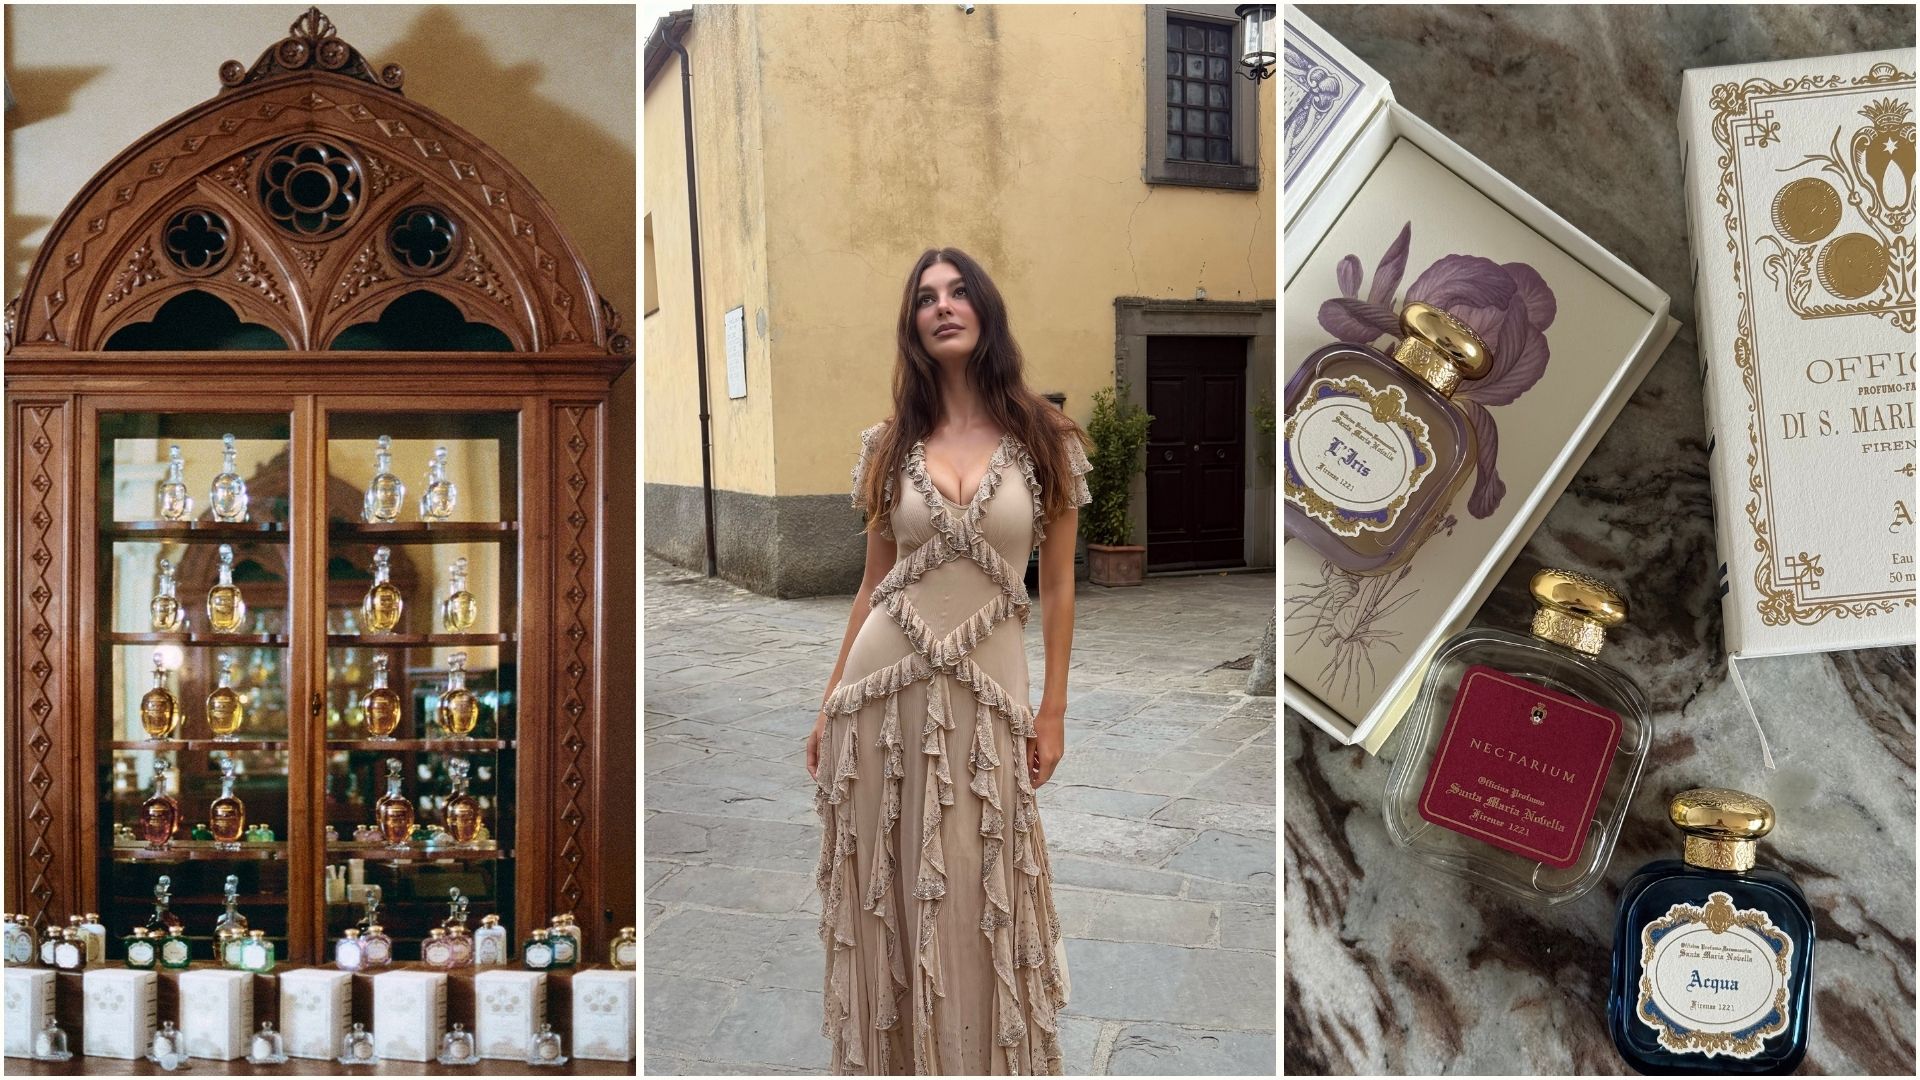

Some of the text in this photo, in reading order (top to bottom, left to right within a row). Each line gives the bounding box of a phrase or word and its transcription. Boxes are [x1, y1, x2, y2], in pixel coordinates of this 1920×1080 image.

[1806, 352, 1916, 384] OFFI
[1780, 411, 1808, 441] DI
[1818, 409, 1839, 437] S.
[1339, 478, 1355, 492] 1221
[1892, 553, 1914, 565] Eau
[1889, 571, 1903, 583] 50
[1470, 737, 1576, 784] NECTARIUM
[1445, 782, 1565, 833] Santa Maria Novella
[1509, 823, 1530, 837] 1221
[1686, 970, 1739, 994] Acqua
[1718, 1003, 1735, 1011] 1221
